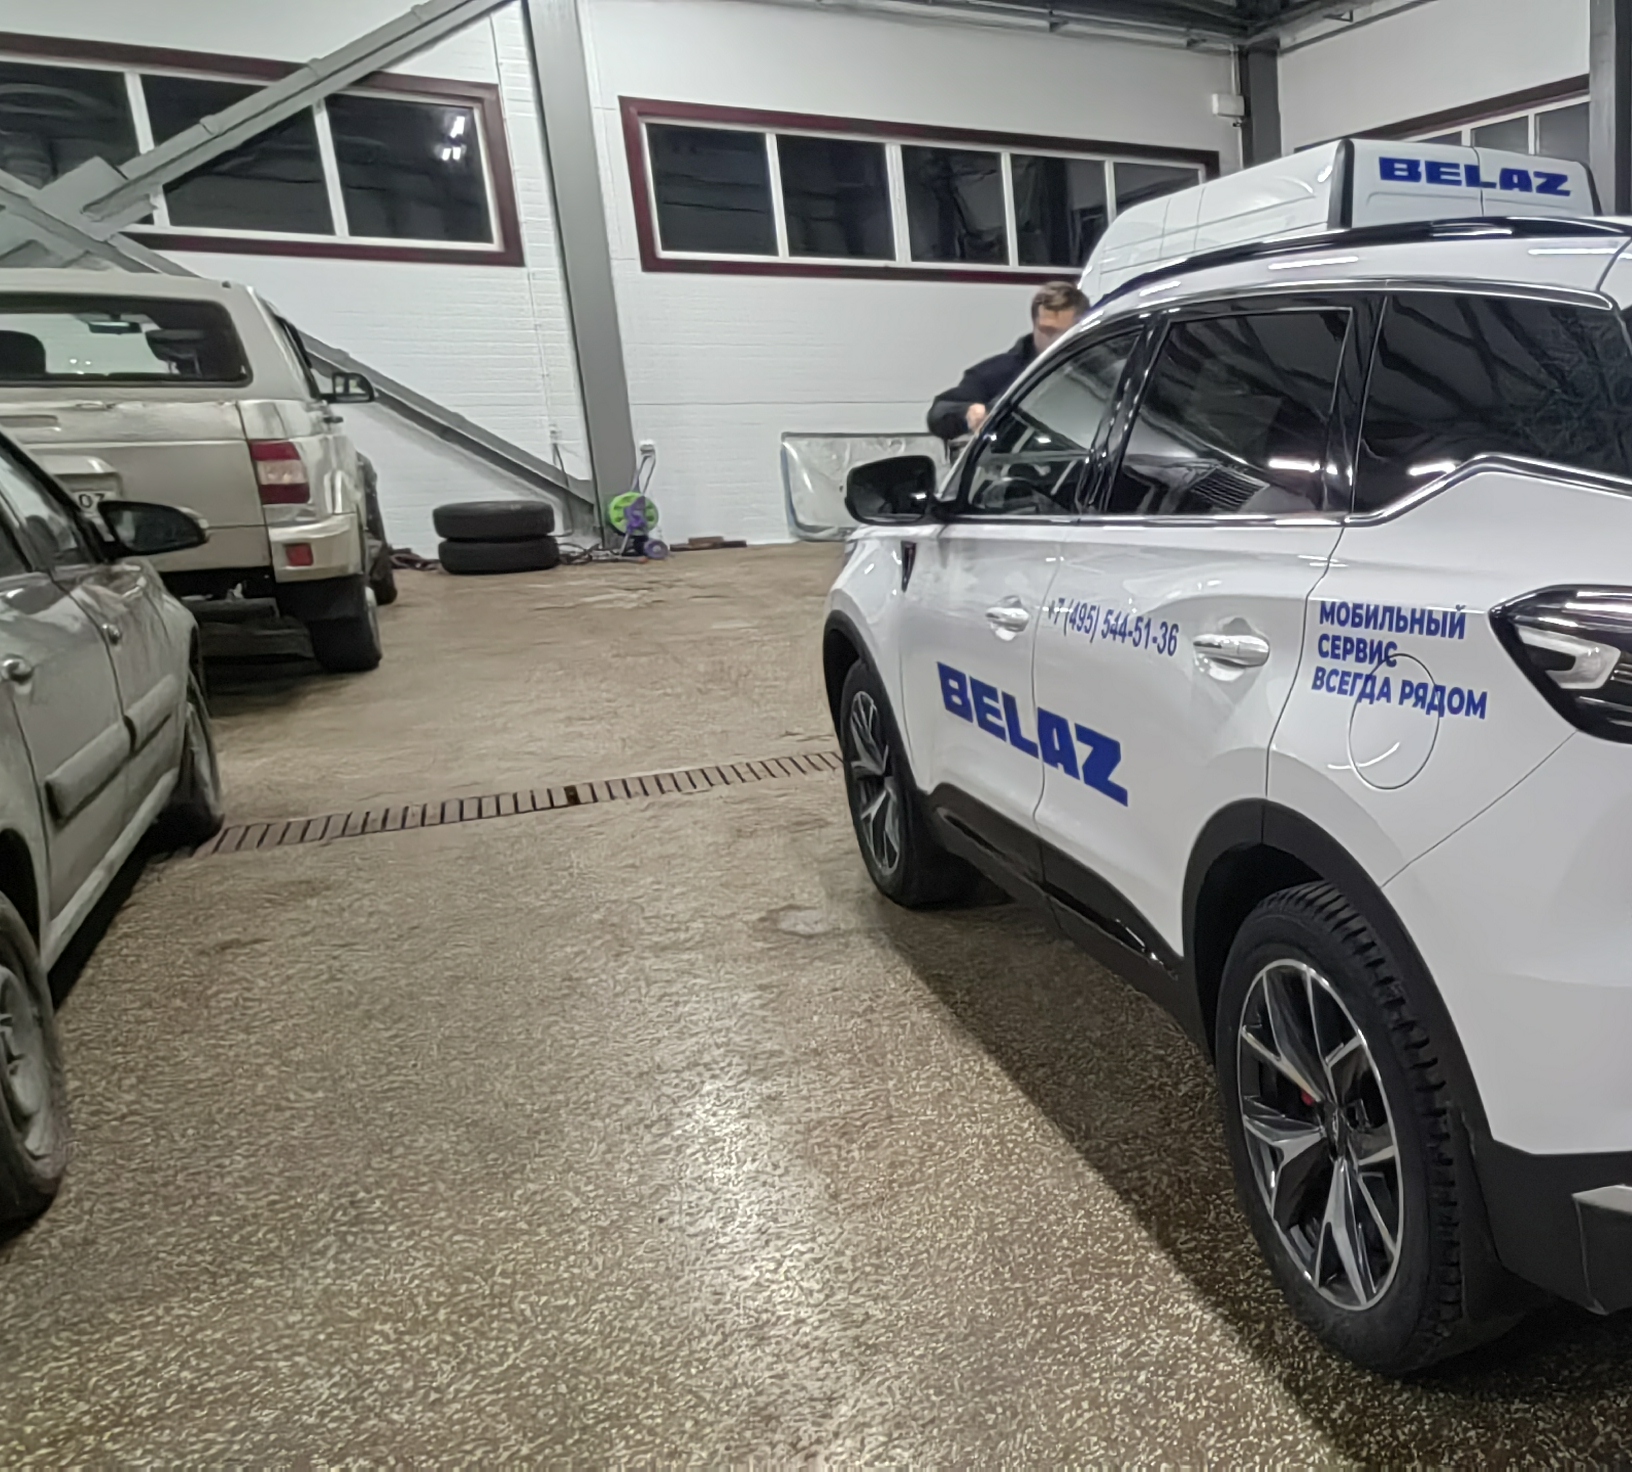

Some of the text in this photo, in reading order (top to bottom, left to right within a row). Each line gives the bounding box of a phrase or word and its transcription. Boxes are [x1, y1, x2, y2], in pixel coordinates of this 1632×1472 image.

[1378, 156, 1571, 197] BELAZ
[1063, 598, 1100, 644] (495)
[1101, 608, 1179, 657] 544-51-36
[1319, 600, 1466, 640] МОБИЛЬНЫЙ
[1317, 633, 1398, 668] СЕРВИС
[1311, 665, 1488, 720] ВСЕГДА РЯДОМ
[936, 660, 1129, 808] BELAZ
